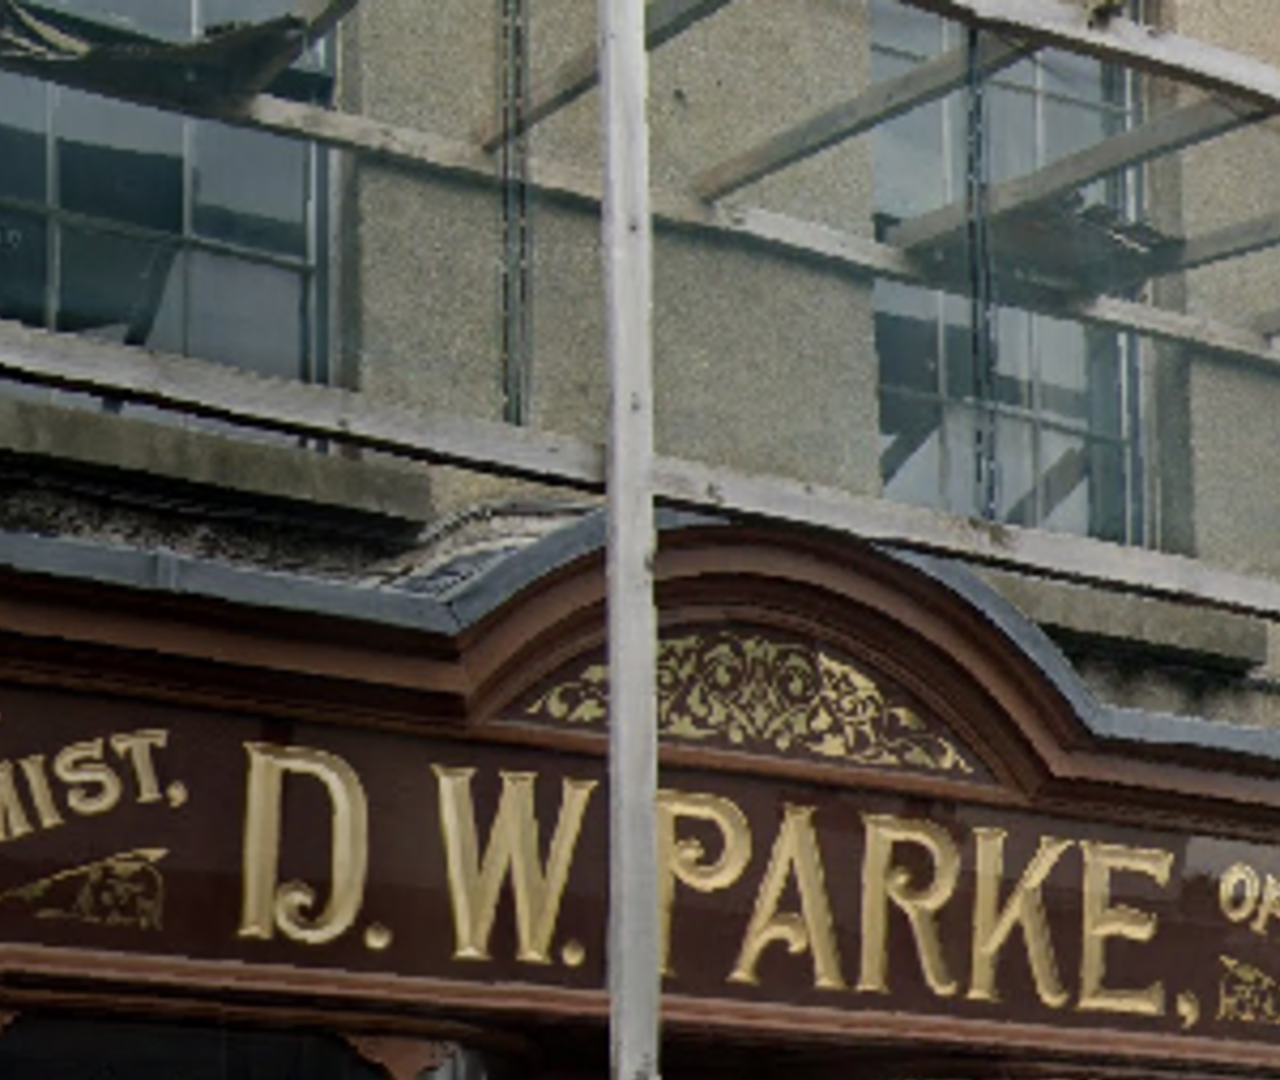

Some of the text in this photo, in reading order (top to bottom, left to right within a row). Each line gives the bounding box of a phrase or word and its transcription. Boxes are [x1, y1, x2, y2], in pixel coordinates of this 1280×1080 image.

[238, 740, 1200, 1028] D. W. PARKE,
